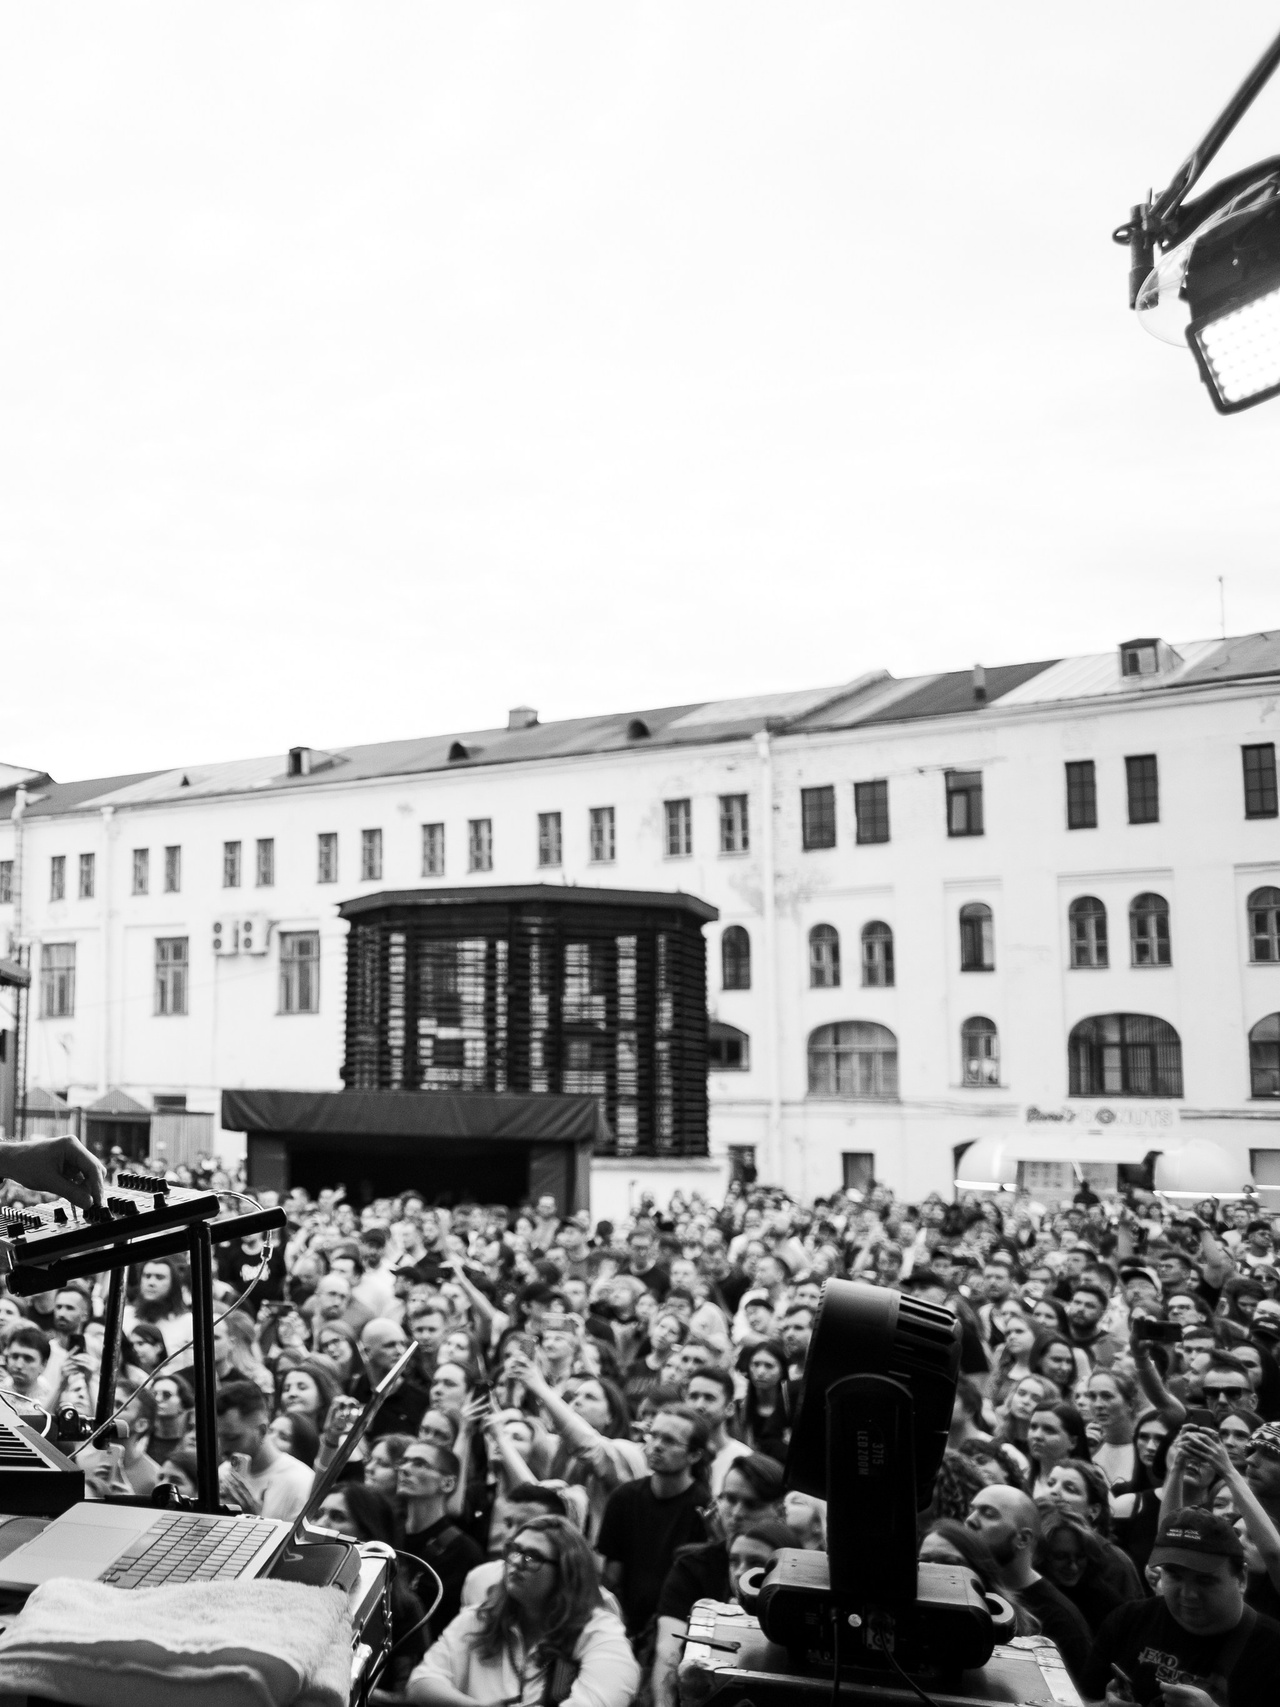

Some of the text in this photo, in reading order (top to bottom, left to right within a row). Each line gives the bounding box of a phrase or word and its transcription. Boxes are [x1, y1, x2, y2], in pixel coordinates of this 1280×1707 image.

[857, 1430, 869, 1475] LED ZOOM
[872, 1442, 884, 1464] 3715
[1142, 1646, 1178, 1669] EMO
